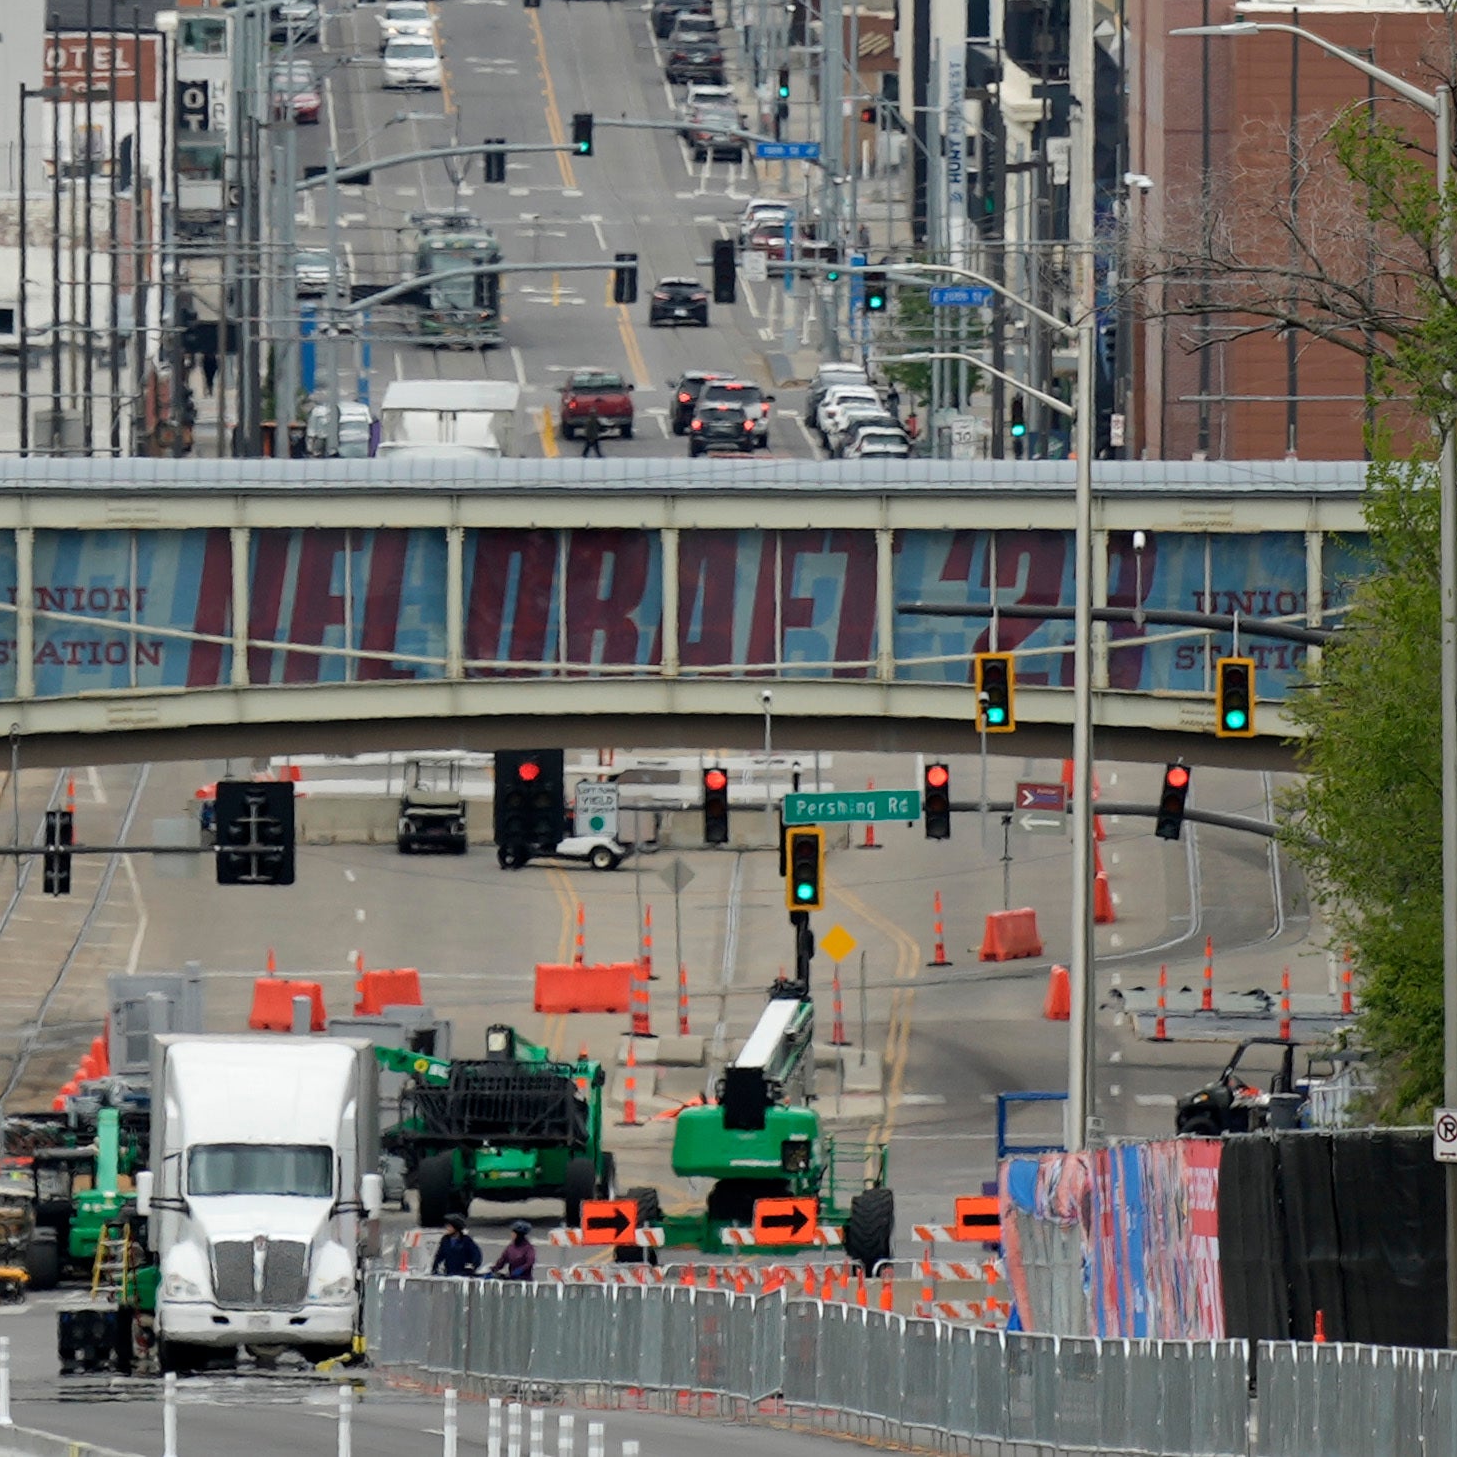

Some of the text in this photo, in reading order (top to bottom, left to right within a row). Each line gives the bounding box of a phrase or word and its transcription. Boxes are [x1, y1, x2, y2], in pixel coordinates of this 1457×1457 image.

[184, 528, 416, 688] NFL
[462, 528, 903, 682] DRAFT
[796, 797, 909, 819] Pershing Rd
